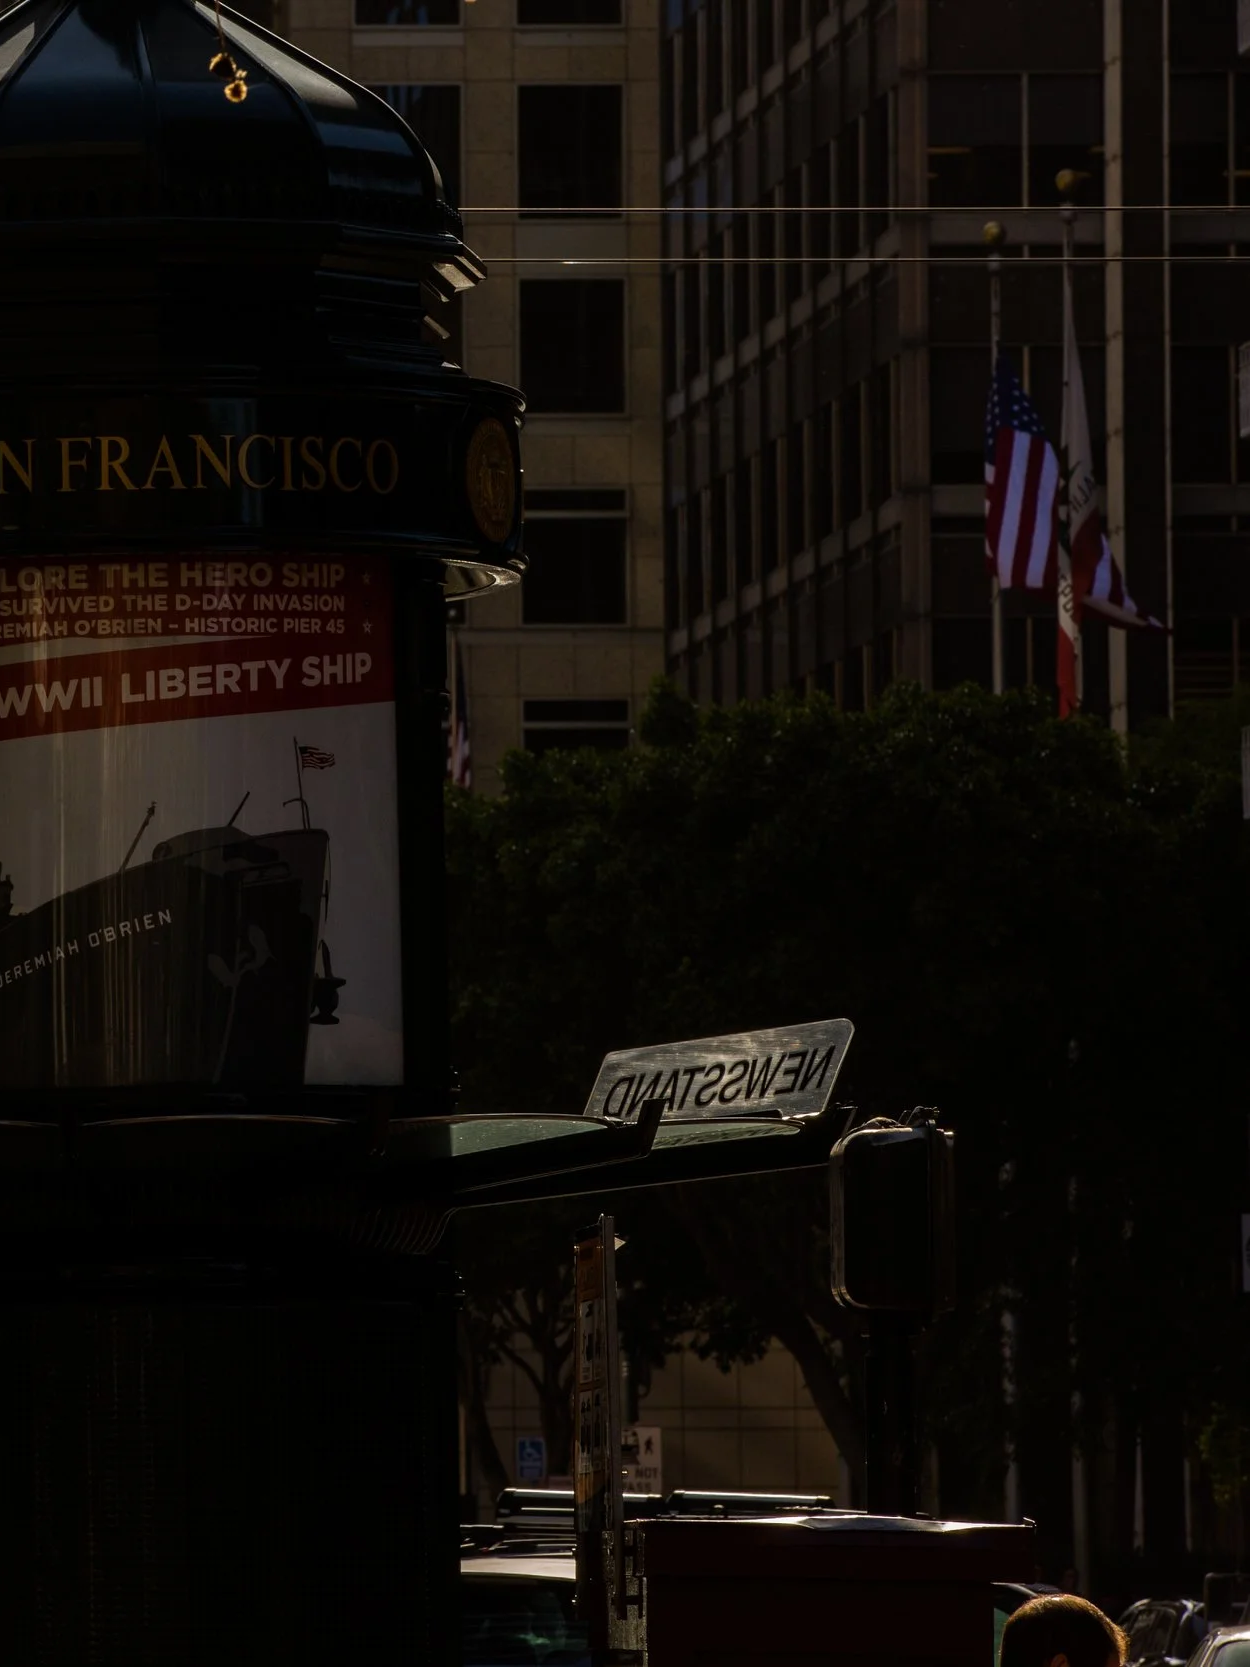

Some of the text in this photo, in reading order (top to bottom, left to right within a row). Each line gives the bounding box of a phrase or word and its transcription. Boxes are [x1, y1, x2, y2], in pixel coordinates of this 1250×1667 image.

[56, 433, 400, 494] FRANCISCO
[99, 562, 169, 589] THE
[180, 561, 274, 588] HERO
[281, 561, 346, 589] SHIP
[121, 593, 169, 612] THE
[175, 593, 246, 612] D-DAY
[253, 593, 345, 613] INVASION
[185, 617, 278, 634] HISTORIC
[283, 617, 322, 635] PIER
[325, 618, 346, 635] 45
[121, 658, 293, 704] LIBERTY
[301, 651, 373, 688] SHIP
[635, 1467, 658, 1479] NOT
